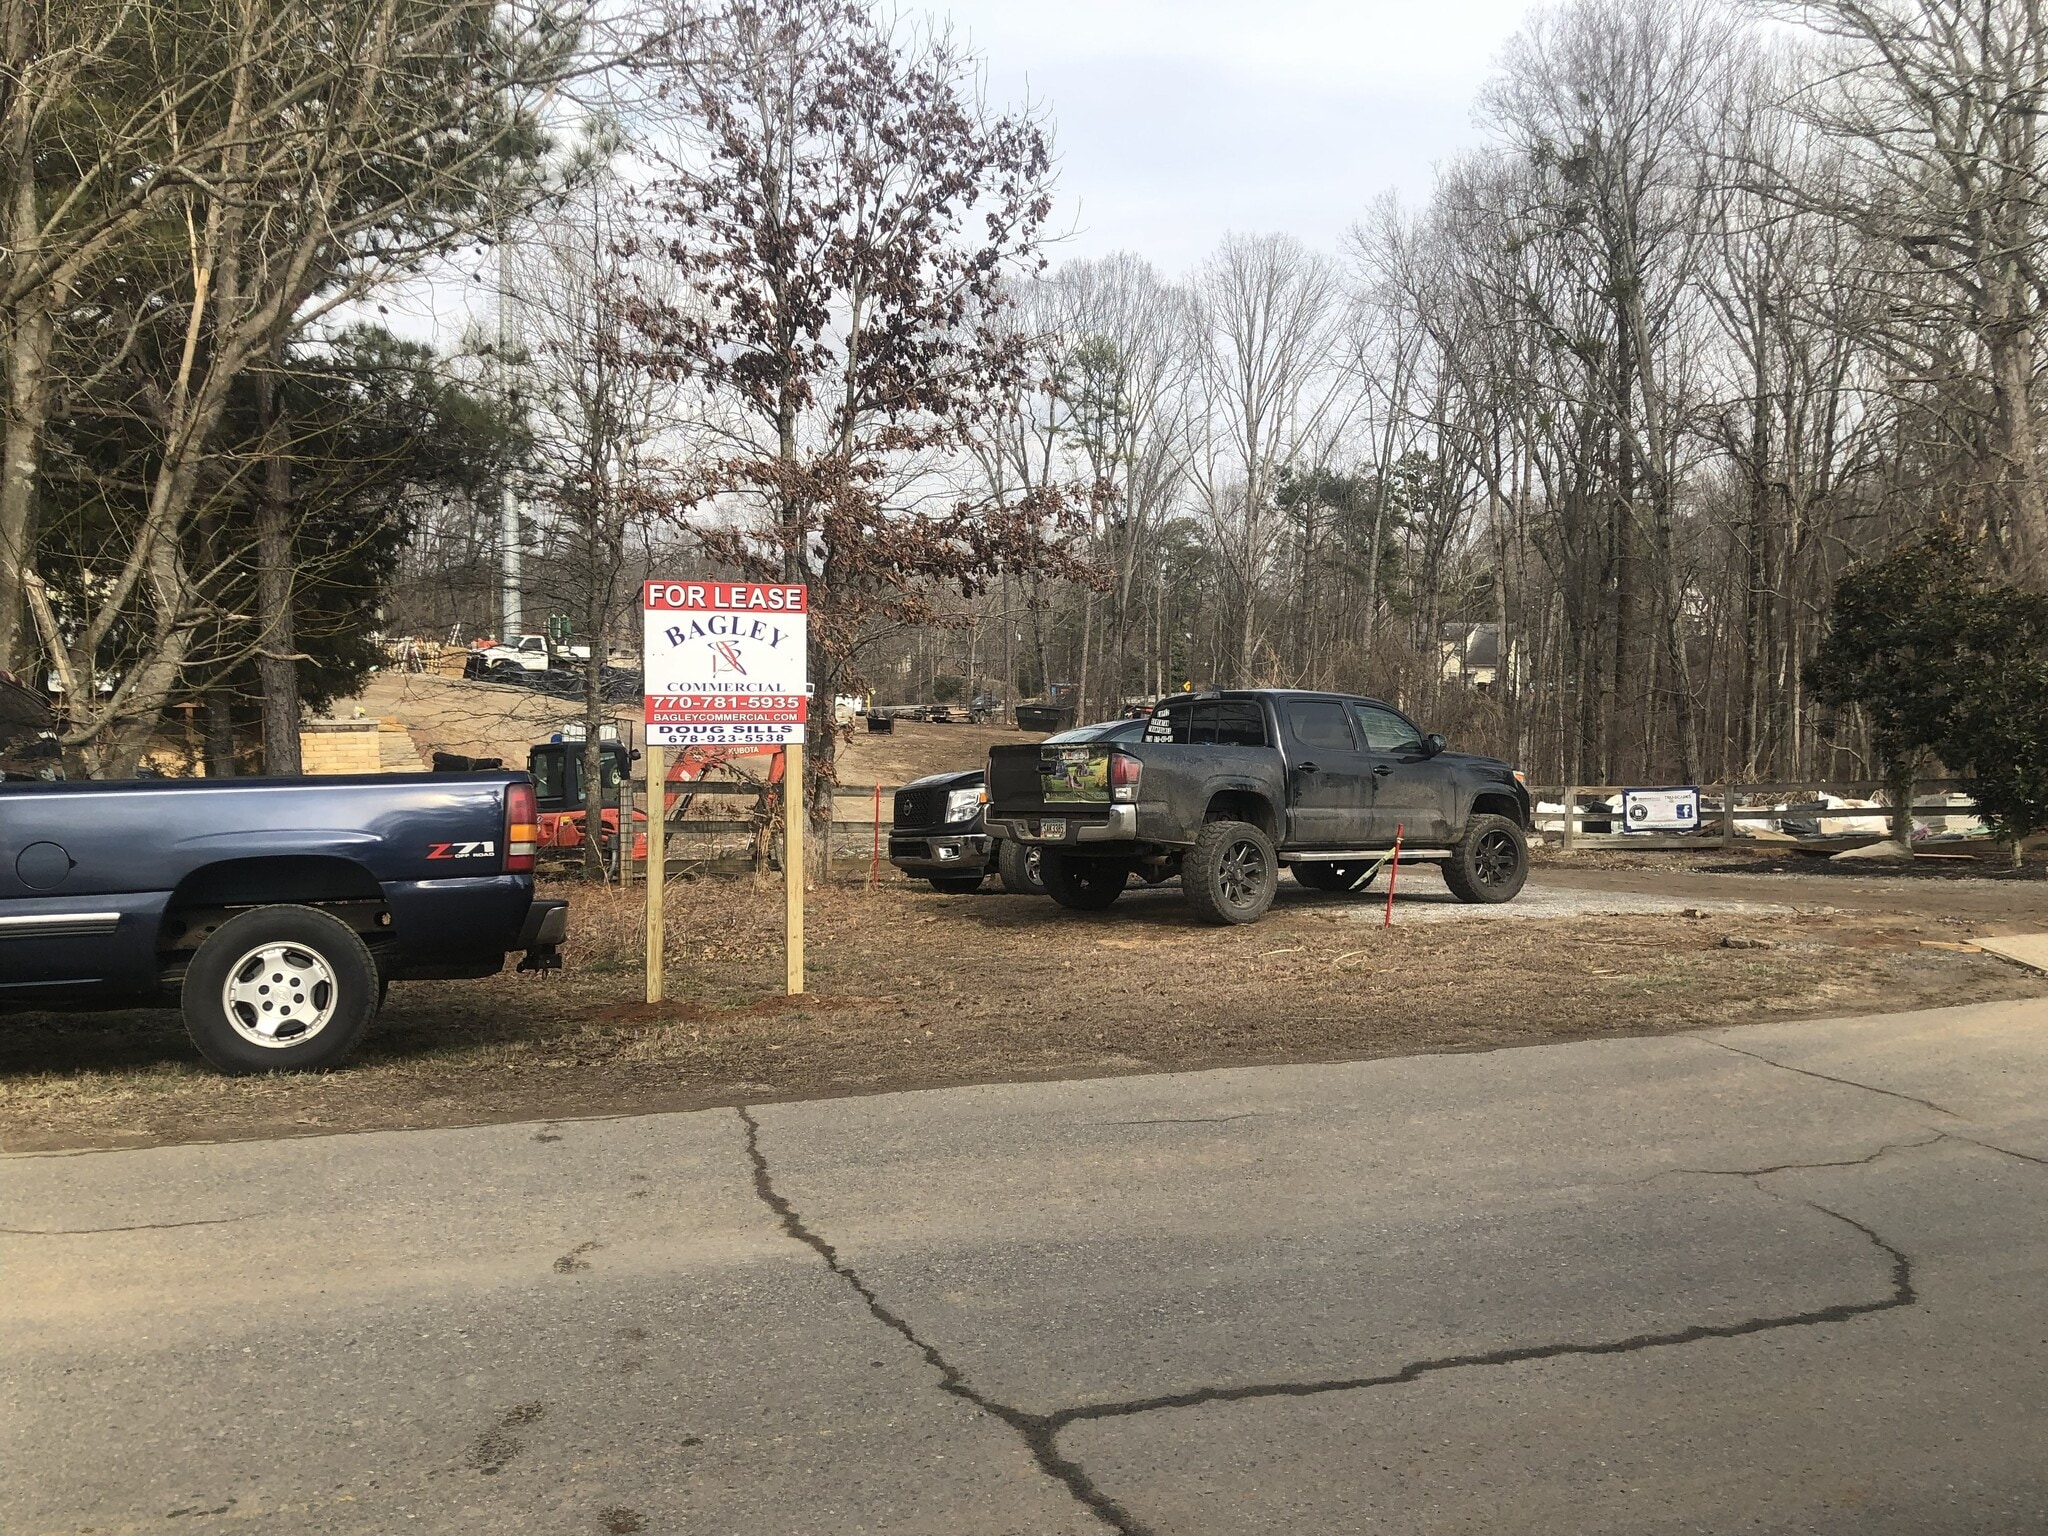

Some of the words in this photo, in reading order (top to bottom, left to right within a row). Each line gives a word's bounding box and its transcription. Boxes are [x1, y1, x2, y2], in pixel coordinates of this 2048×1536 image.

[649, 584, 706, 608] FOR
[714, 586, 802, 609] LEASE
[664, 615, 789, 650] BAGLEY
[667, 682, 786, 692] COMMERCIAL
[652, 697, 799, 709] 770-781-5935
[653, 713, 798, 721] BAGLEYCOMMERCIAL.COM
[659, 725, 725, 734] DOUG
[732, 725, 793, 733] SILLS
[668, 734, 785, 743] 678-923-5538
[728, 746, 759, 754] KUBOTA
[426, 841, 494, 859] Z71
